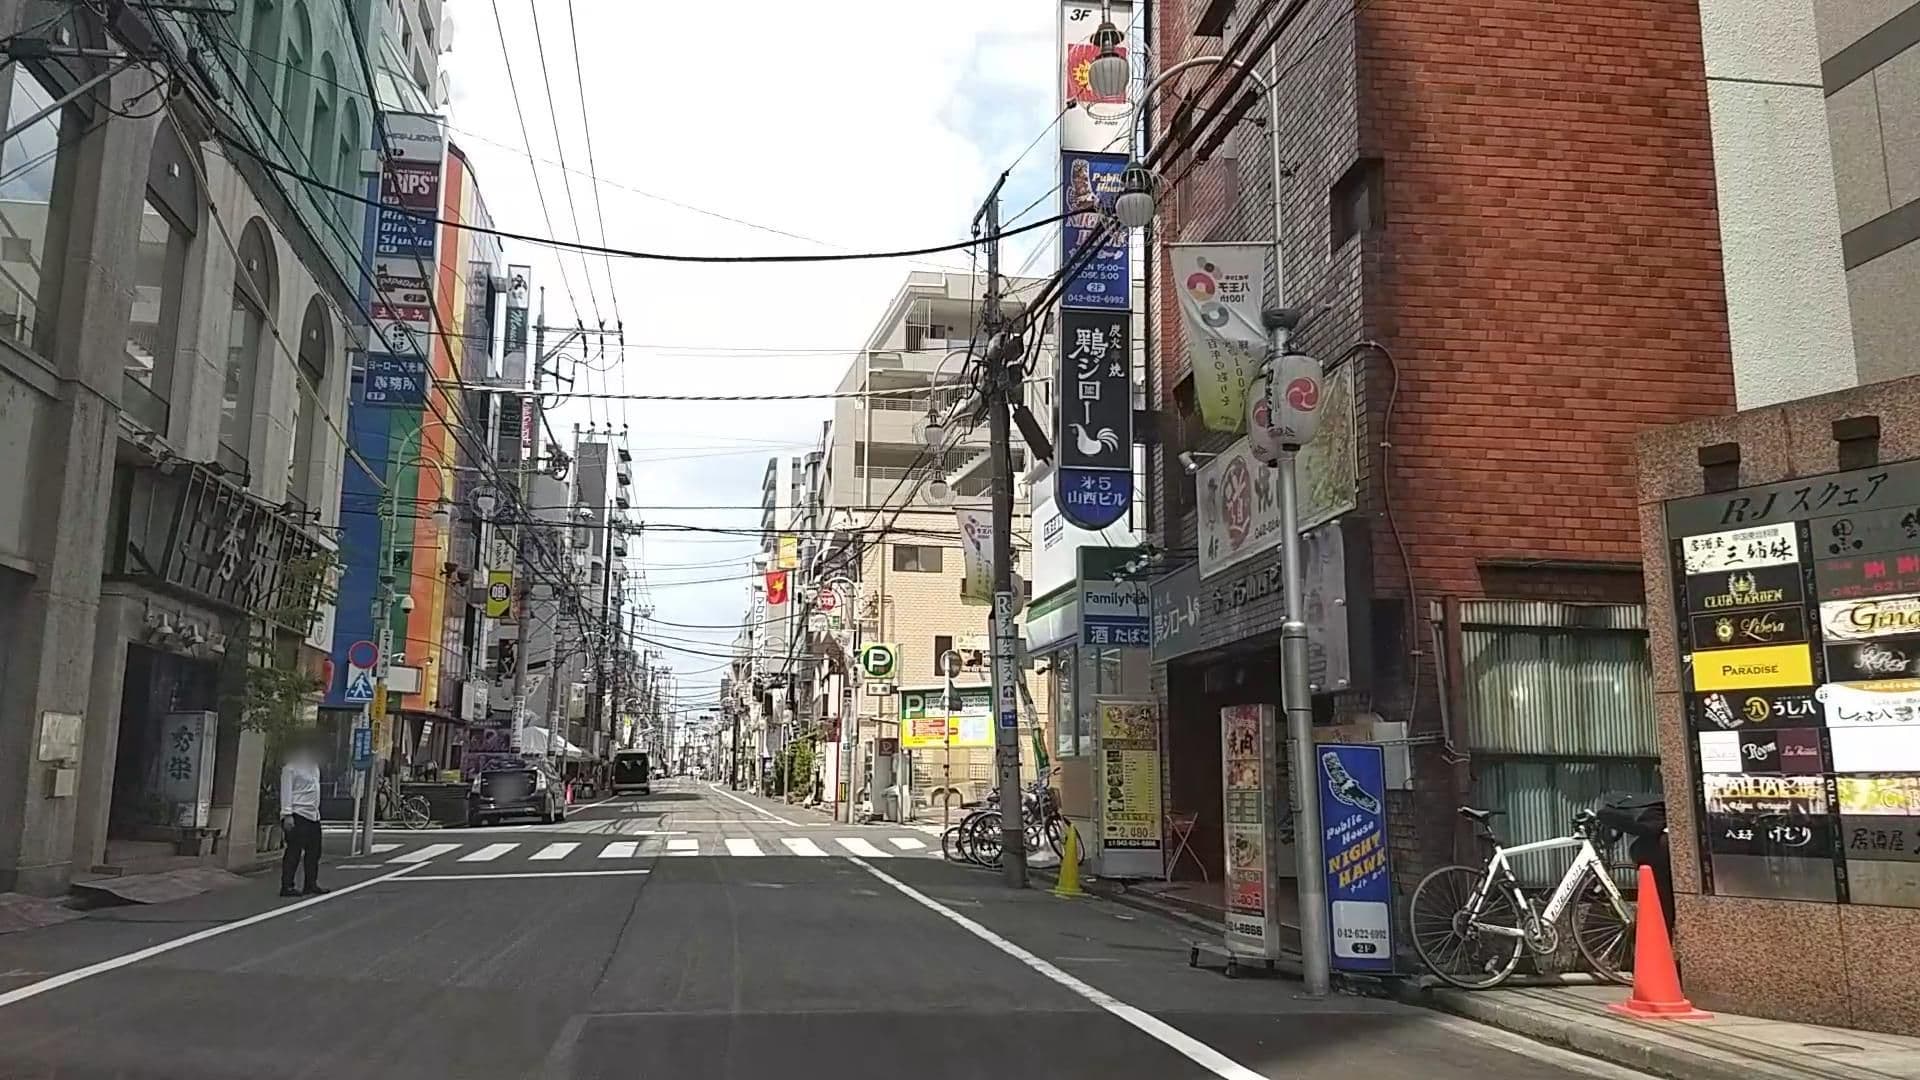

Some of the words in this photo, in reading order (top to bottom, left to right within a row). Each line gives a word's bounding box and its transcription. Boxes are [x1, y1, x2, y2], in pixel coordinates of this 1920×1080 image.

[1070, 9, 1092, 22] 3F
[1092, 172, 1124, 184] Publi
[1068, 490, 1126, 506] 山西ビル
[1720, 493, 1777, 524] RJ
[1085, 591, 1149, 607] FamilyM
[1703, 594, 1734, 608] CLUB
[1735, 589, 1784, 604] GARDEN
[1090, 626, 1109, 643] 酒
[1114, 626, 1149, 643] たばこ
[868, 649, 891, 672] P
[905, 695, 924, 718] P
[1772, 699, 1817, 716] うし八
[1827, 779, 1837, 807] 2F
[1326, 813, 1363, 841] Public
[1341, 820, 1375, 846] House
[1768, 825, 1812, 847] けむり
[1850, 827, 1905, 851] 居酒屋
[1328, 830, 1381, 875] NIGHT
[1338, 847, 1387, 889] HAWK
